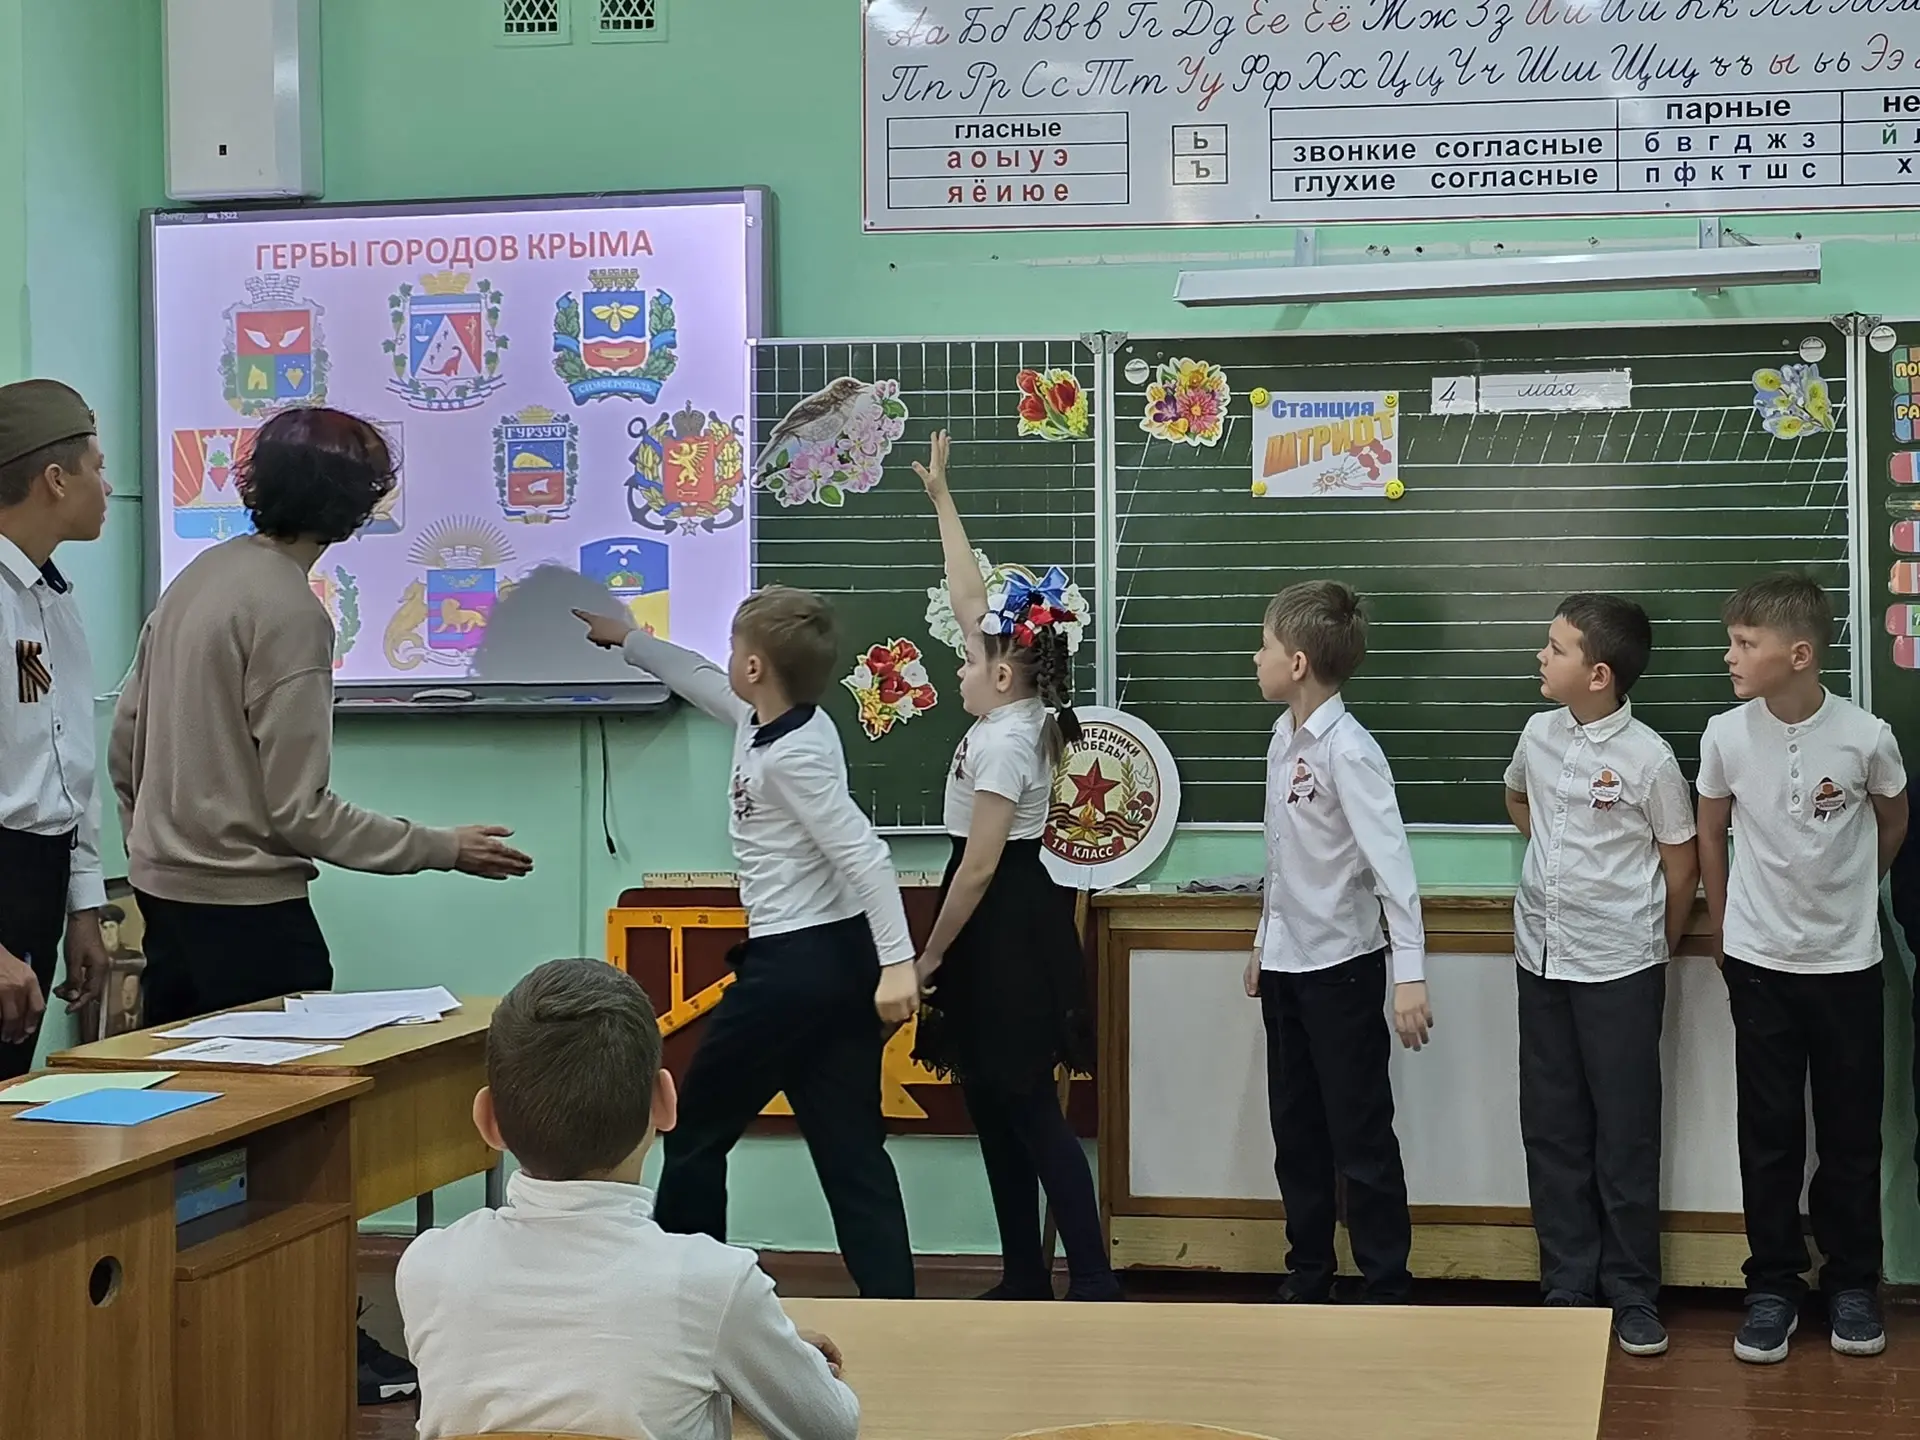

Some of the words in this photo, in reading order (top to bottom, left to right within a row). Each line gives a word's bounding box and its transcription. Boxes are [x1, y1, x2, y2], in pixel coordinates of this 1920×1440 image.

[958, 7, 1026, 44] Бб
[1119, 2, 1163, 39] Гг
[1172, 0, 1236, 55] Дд
[882, 65, 952, 101] Пп
[959, 61, 1011, 115] Рр
[1022, 60, 1069, 98] Сс
[1077, 58, 1168, 96] Тт
[1176, 55, 1225, 112] Уу
[1232, 54, 1291, 108] Фф
[1299, 51, 1368, 90] Хх
[1377, 50, 1445, 98] Цц
[1448, 46, 1505, 85] Чч
[1516, 45, 1601, 84] Шш
[1610, 43, 1700, 91] Щщ
[1666, 98, 1791, 124] парные
[954, 120, 1062, 140] гласные
[1644, 131, 1660, 152] б
[1677, 135, 1692, 151] в
[1709, 135, 1720, 151] г
[1734, 134, 1752, 153] д
[1767, 132, 1787, 149] ж
[947, 149, 962, 169] а
[970, 149, 987, 169] о
[996, 148, 1020, 168] ы
[1029, 148, 1044, 173] у
[1053, 148, 1068, 167] э
[1293, 142, 1417, 162] звонкие
[1435, 136, 1604, 158] согласные
[1294, 173, 1396, 197] глухие
[1431, 167, 1599, 190] согласные
[1645, 166, 1660, 183] п
[1674, 161, 1696, 187] ф
[1711, 164, 1724, 181] к
[1738, 163, 1752, 180] т
[1767, 163, 1787, 180] ш
[947, 183, 963, 203] я
[972, 178, 987, 203] ё
[996, 183, 1012, 203] и
[1022, 183, 1045, 202] ю
[1054, 182, 1069, 202] е
[256, 240, 358, 269] ГЕРБЫ
[367, 234, 519, 270] ГОРОДОВ
[528, 229, 653, 260] КРЫМА
[1895, 361, 1920, 378] ПО
[1438, 380, 1457, 409] 4
[1517, 375, 1580, 398] мая
[1271, 399, 1375, 420] Станция
[507, 426, 565, 438] ГУРЗУФ
[1073, 740, 1126, 761] ПОБЕДЫ
[1082, 727, 1142, 758] ЛЕДНИКИ
[1052, 837, 1068, 854] 1А
[1072, 844, 1115, 860] КЛАСС
